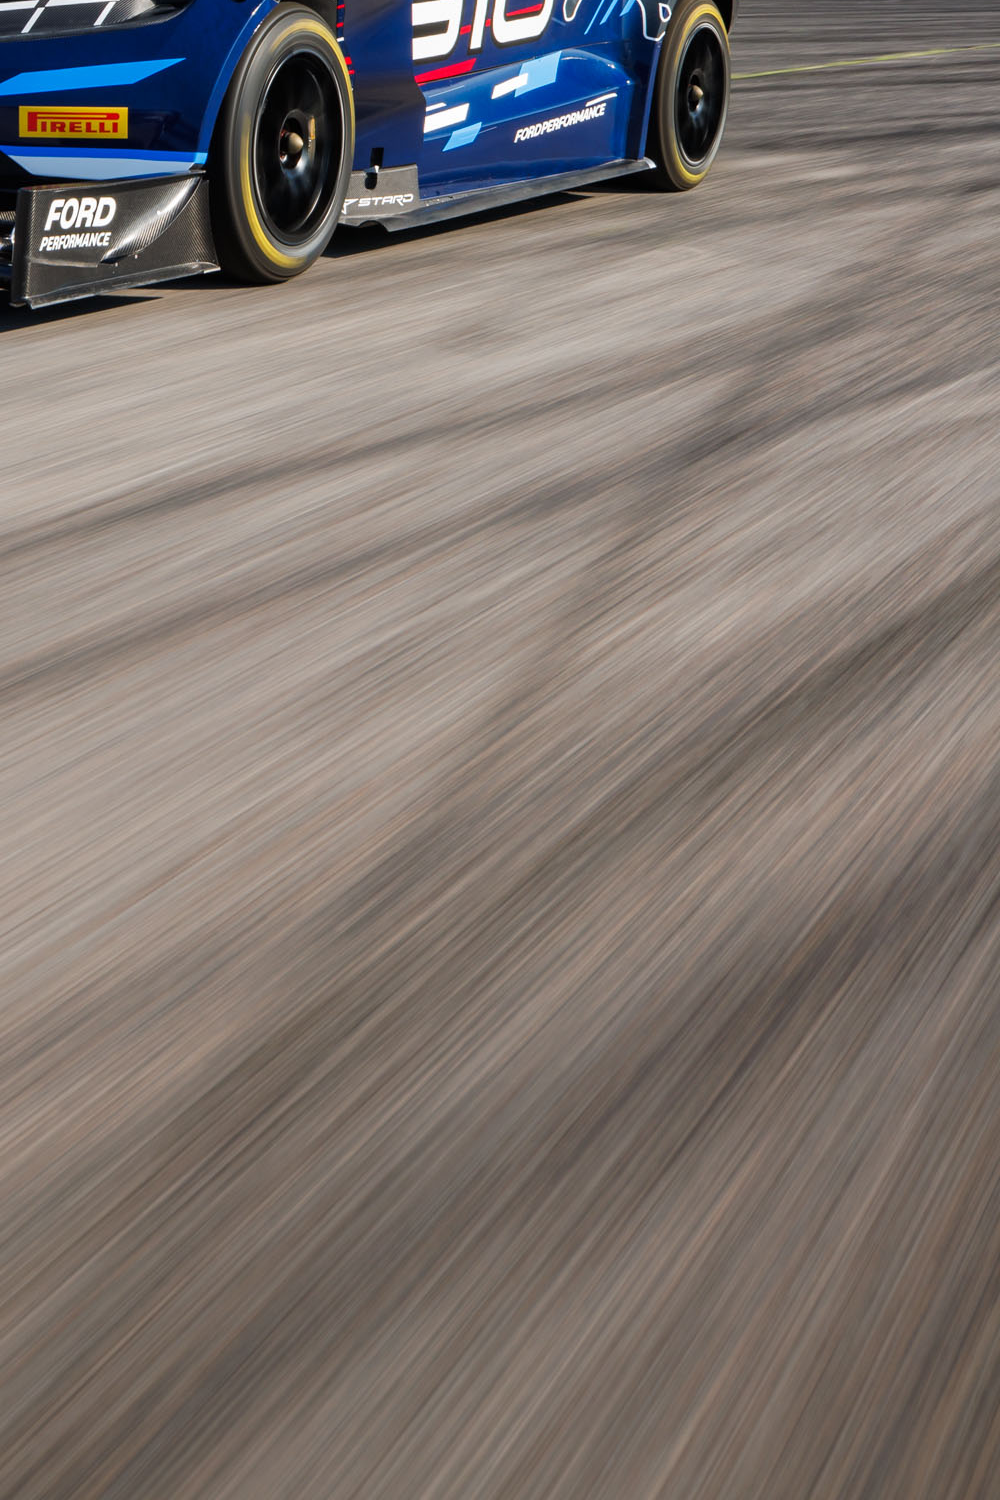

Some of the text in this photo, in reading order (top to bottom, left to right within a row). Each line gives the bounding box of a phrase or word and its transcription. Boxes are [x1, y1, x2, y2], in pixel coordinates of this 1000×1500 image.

[27, 111, 120, 133] PIRELLI
[357, 193, 414, 207] STARD
[44, 196, 117, 231] FORD
[39, 232, 112, 251] PERFORMANCE
